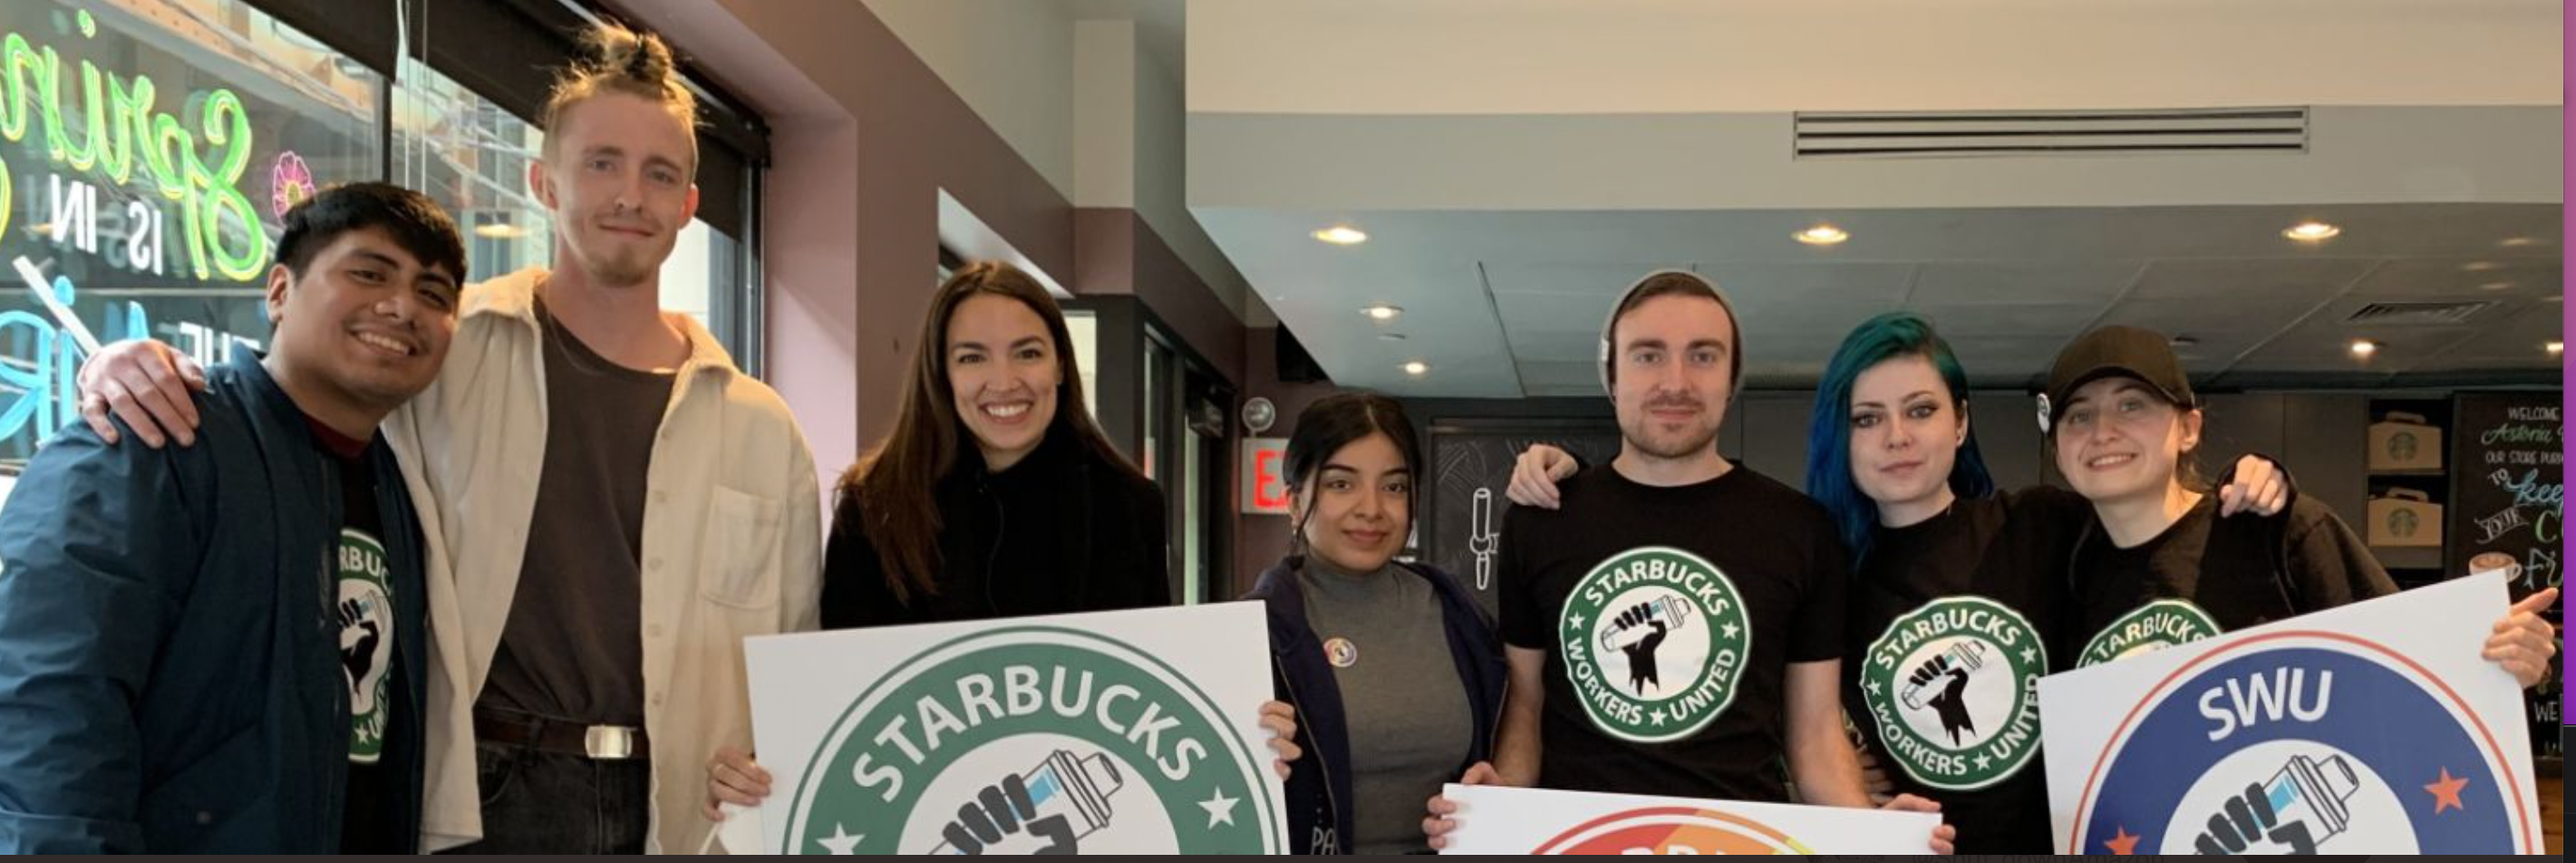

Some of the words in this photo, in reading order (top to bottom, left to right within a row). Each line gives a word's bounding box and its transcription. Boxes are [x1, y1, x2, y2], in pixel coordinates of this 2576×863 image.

[2507, 406, 2561, 421] WELCOME
[2487, 467, 2509, 486] TO
[1585, 558, 1730, 616] STARBUCKS
[1875, 608, 2022, 671] STARBUCKS
[1566, 636, 1643, 726] WORKERS
[1668, 648, 1736, 722] UNITED
[2198, 666, 2333, 742] SWU
[853, 664, 1207, 803] STARBUCKS
[1874, 702, 1968, 776] WORKERS
[1990, 673, 2040, 761] UNITED
